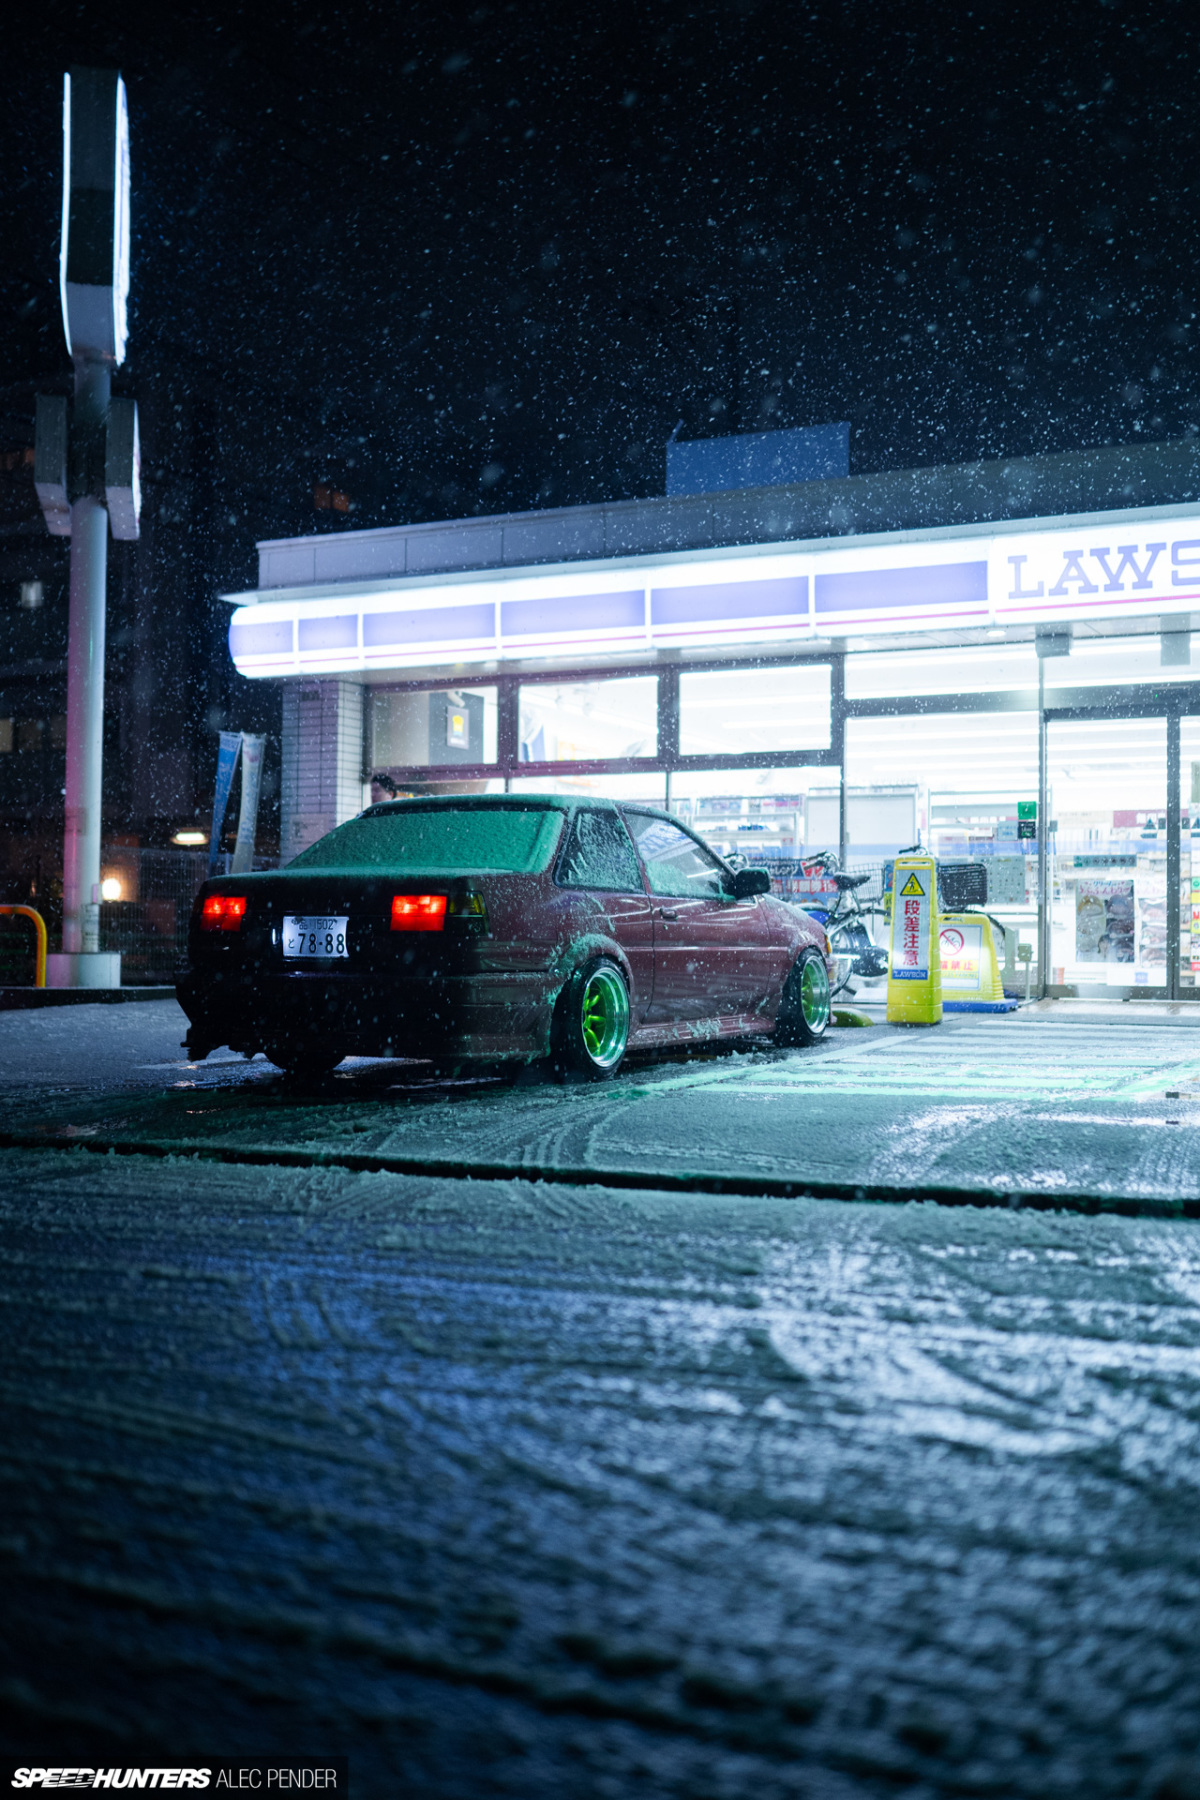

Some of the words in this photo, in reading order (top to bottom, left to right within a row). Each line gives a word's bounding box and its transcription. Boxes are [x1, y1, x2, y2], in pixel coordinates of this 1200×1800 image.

[288, 938, 295, 948] と
[903, 899, 921, 966] 段差注意
